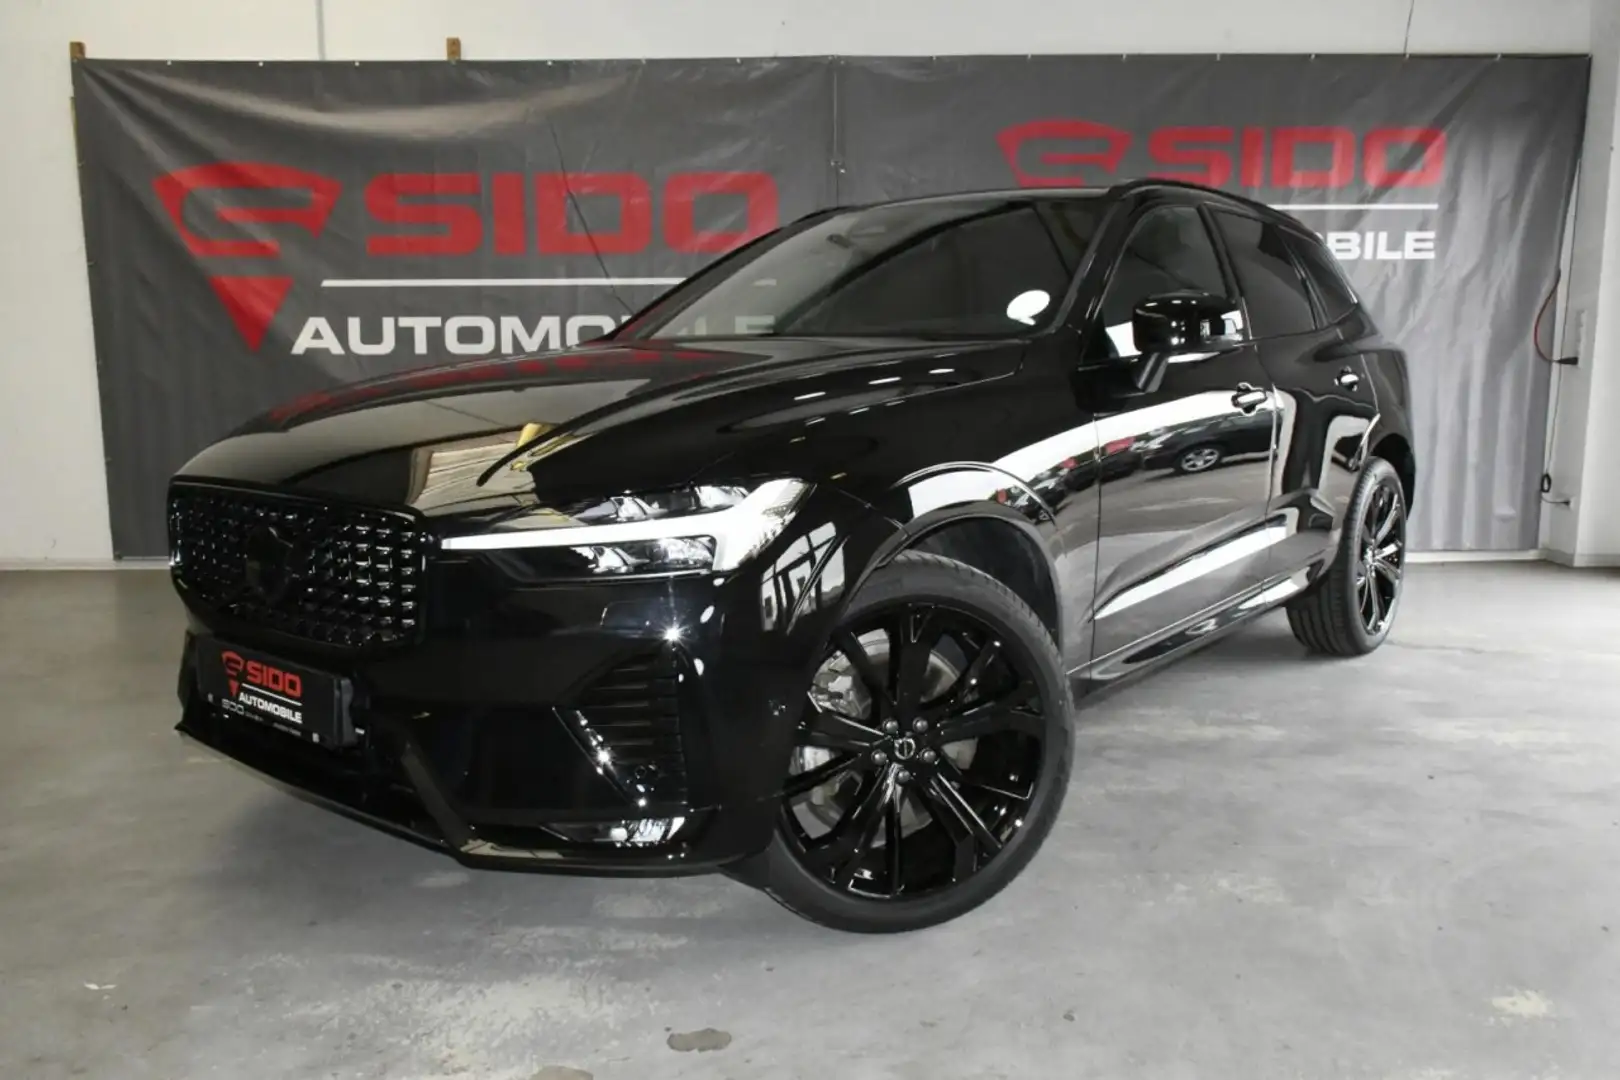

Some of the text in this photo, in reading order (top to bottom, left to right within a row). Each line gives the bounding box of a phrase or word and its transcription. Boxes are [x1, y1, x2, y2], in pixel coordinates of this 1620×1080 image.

[1148, 126, 1446, 188] SIDO
[363, 172, 779, 255] SIDO
[1315, 231, 1436, 260] BILE
[246, 660, 303, 697] SIDO
[239, 691, 303, 724] AUTOMOBILE
